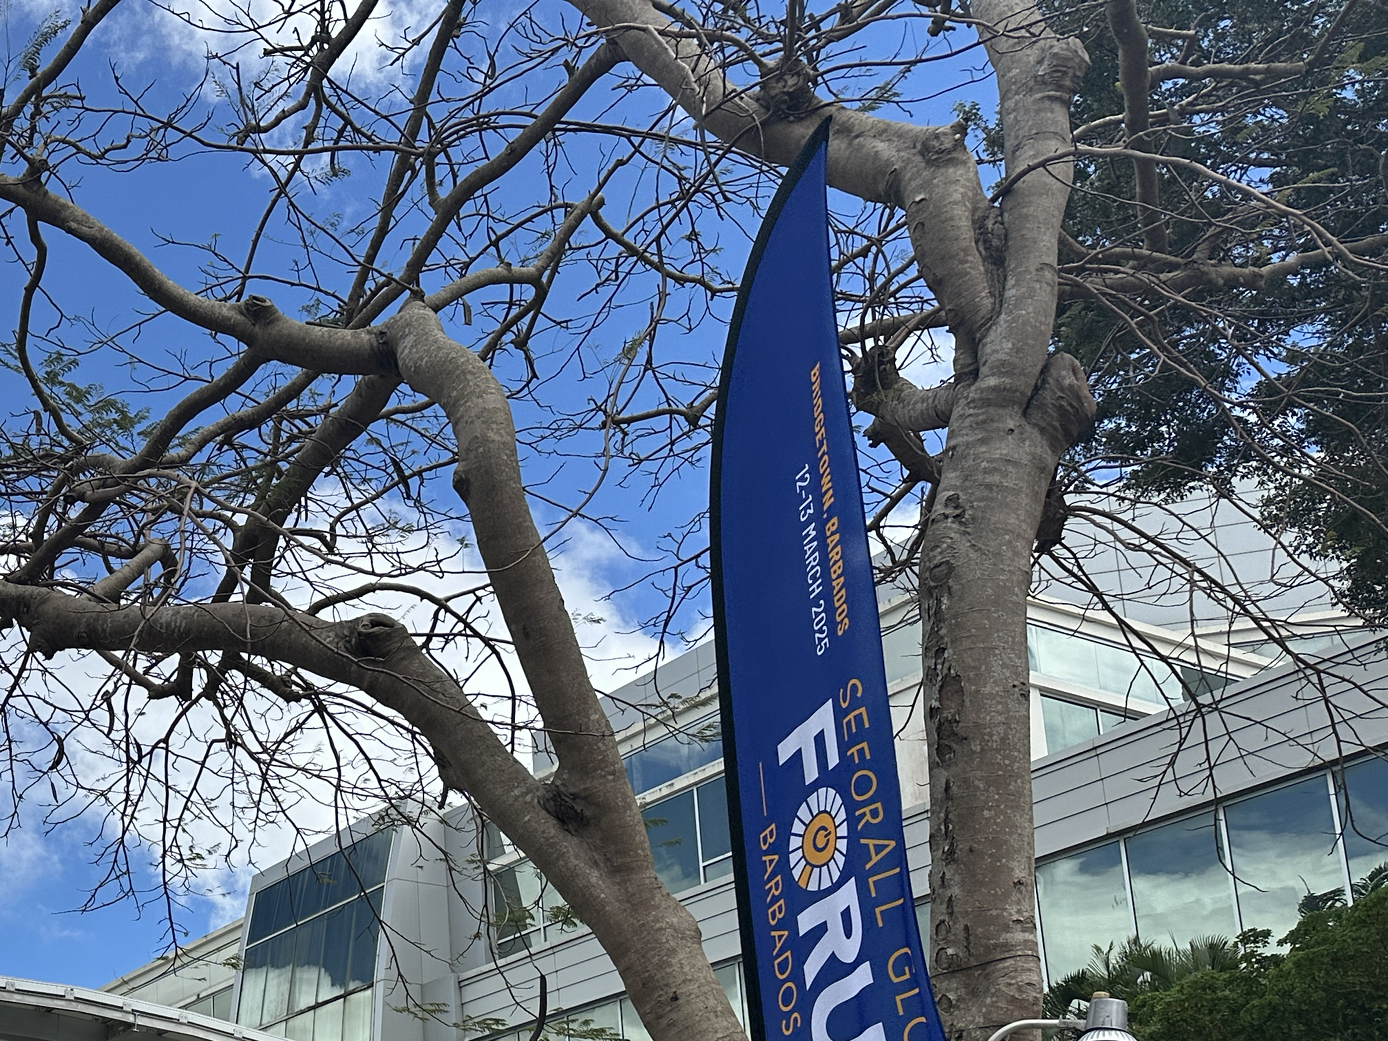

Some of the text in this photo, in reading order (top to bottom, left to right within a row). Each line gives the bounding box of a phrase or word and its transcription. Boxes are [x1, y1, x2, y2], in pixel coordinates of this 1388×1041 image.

[794, 463, 830, 656] 12-13 MARCH 2025
[825, 515, 850, 636] BARBADOS
[839, 678, 904, 928] SEFORALL
[758, 822, 802, 1037] BARBADOS
